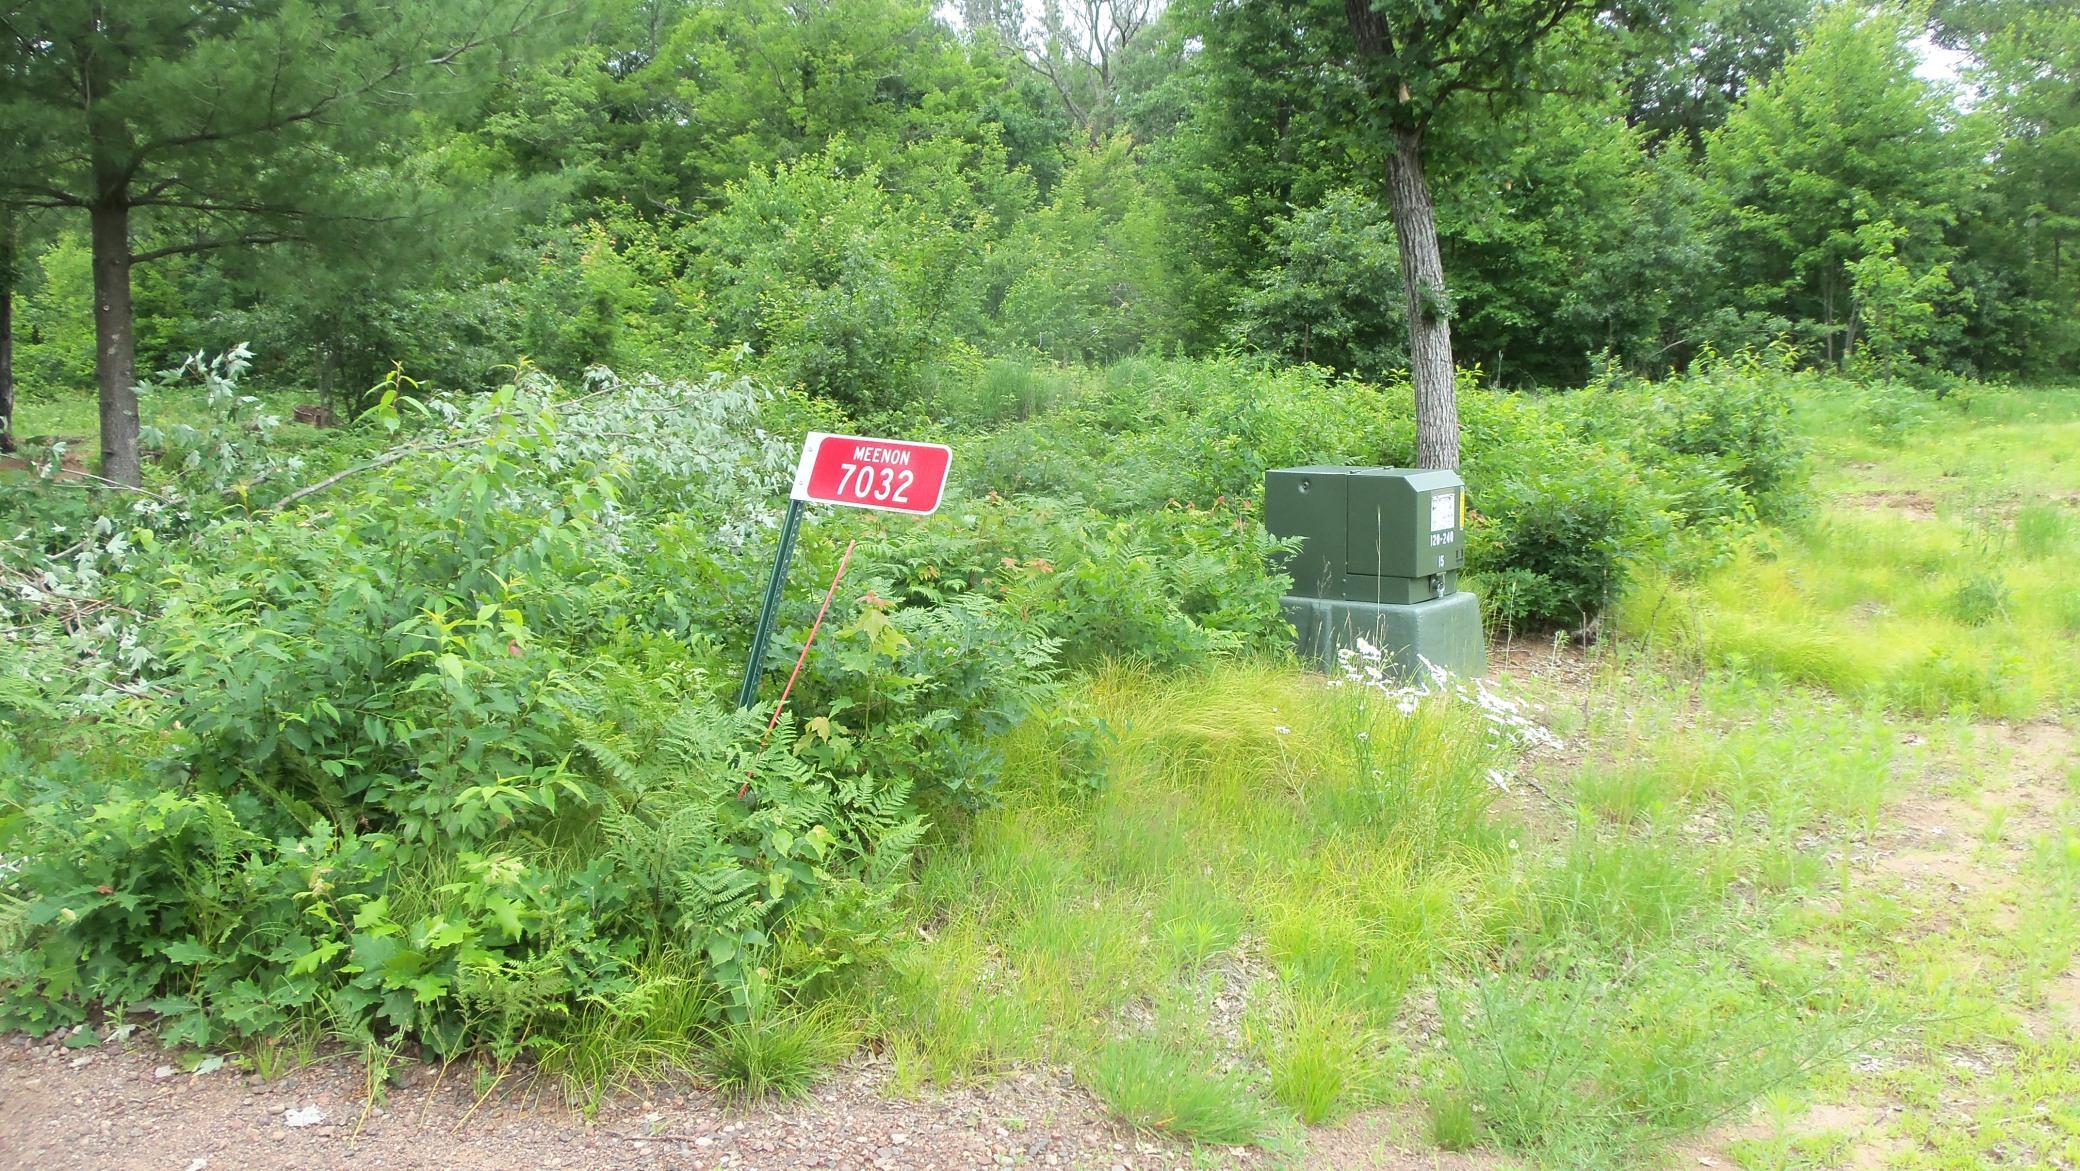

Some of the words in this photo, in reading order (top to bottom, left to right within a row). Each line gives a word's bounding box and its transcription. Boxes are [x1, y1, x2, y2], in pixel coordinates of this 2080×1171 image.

[854, 446, 911, 466] MEENON
[837, 463, 914, 503] 7032
[1430, 531, 1454, 547] 120-240
[1438, 555, 1444, 568] 15
